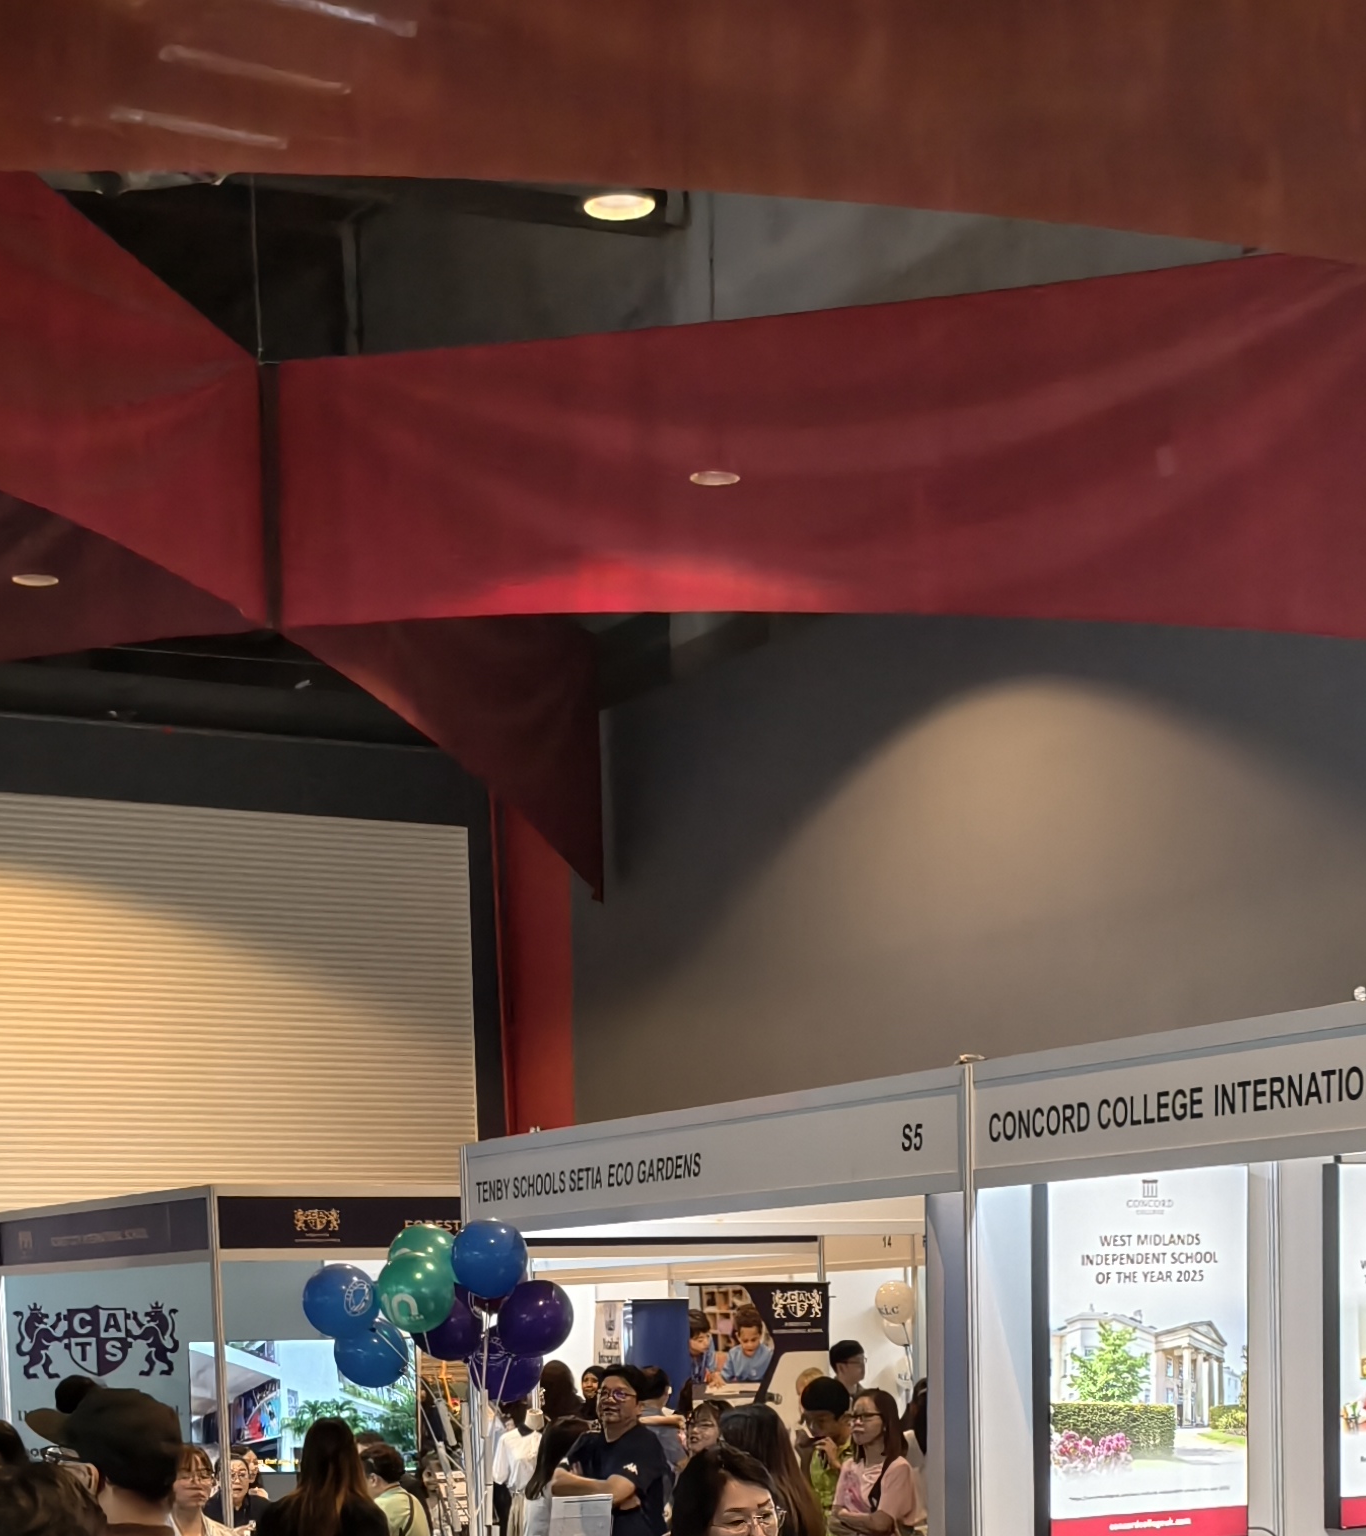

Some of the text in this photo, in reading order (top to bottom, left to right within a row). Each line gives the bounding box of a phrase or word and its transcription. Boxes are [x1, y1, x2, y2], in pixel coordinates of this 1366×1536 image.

[989, 1102, 1090, 1142] CONCORD
[1097, 1087, 1203, 1130] COLLEGE
[901, 1122, 923, 1152] S5
[475, 1152, 701, 1204] TENBY SCHOOLS SETIA ECO GARDENS
[1099, 1233, 1201, 1247] WEST MIDLANDS
[1081, 1251, 1218, 1266] INDEPENDENT SCHOOL
[1095, 1269, 1204, 1284] OF THE YEAR 2025
